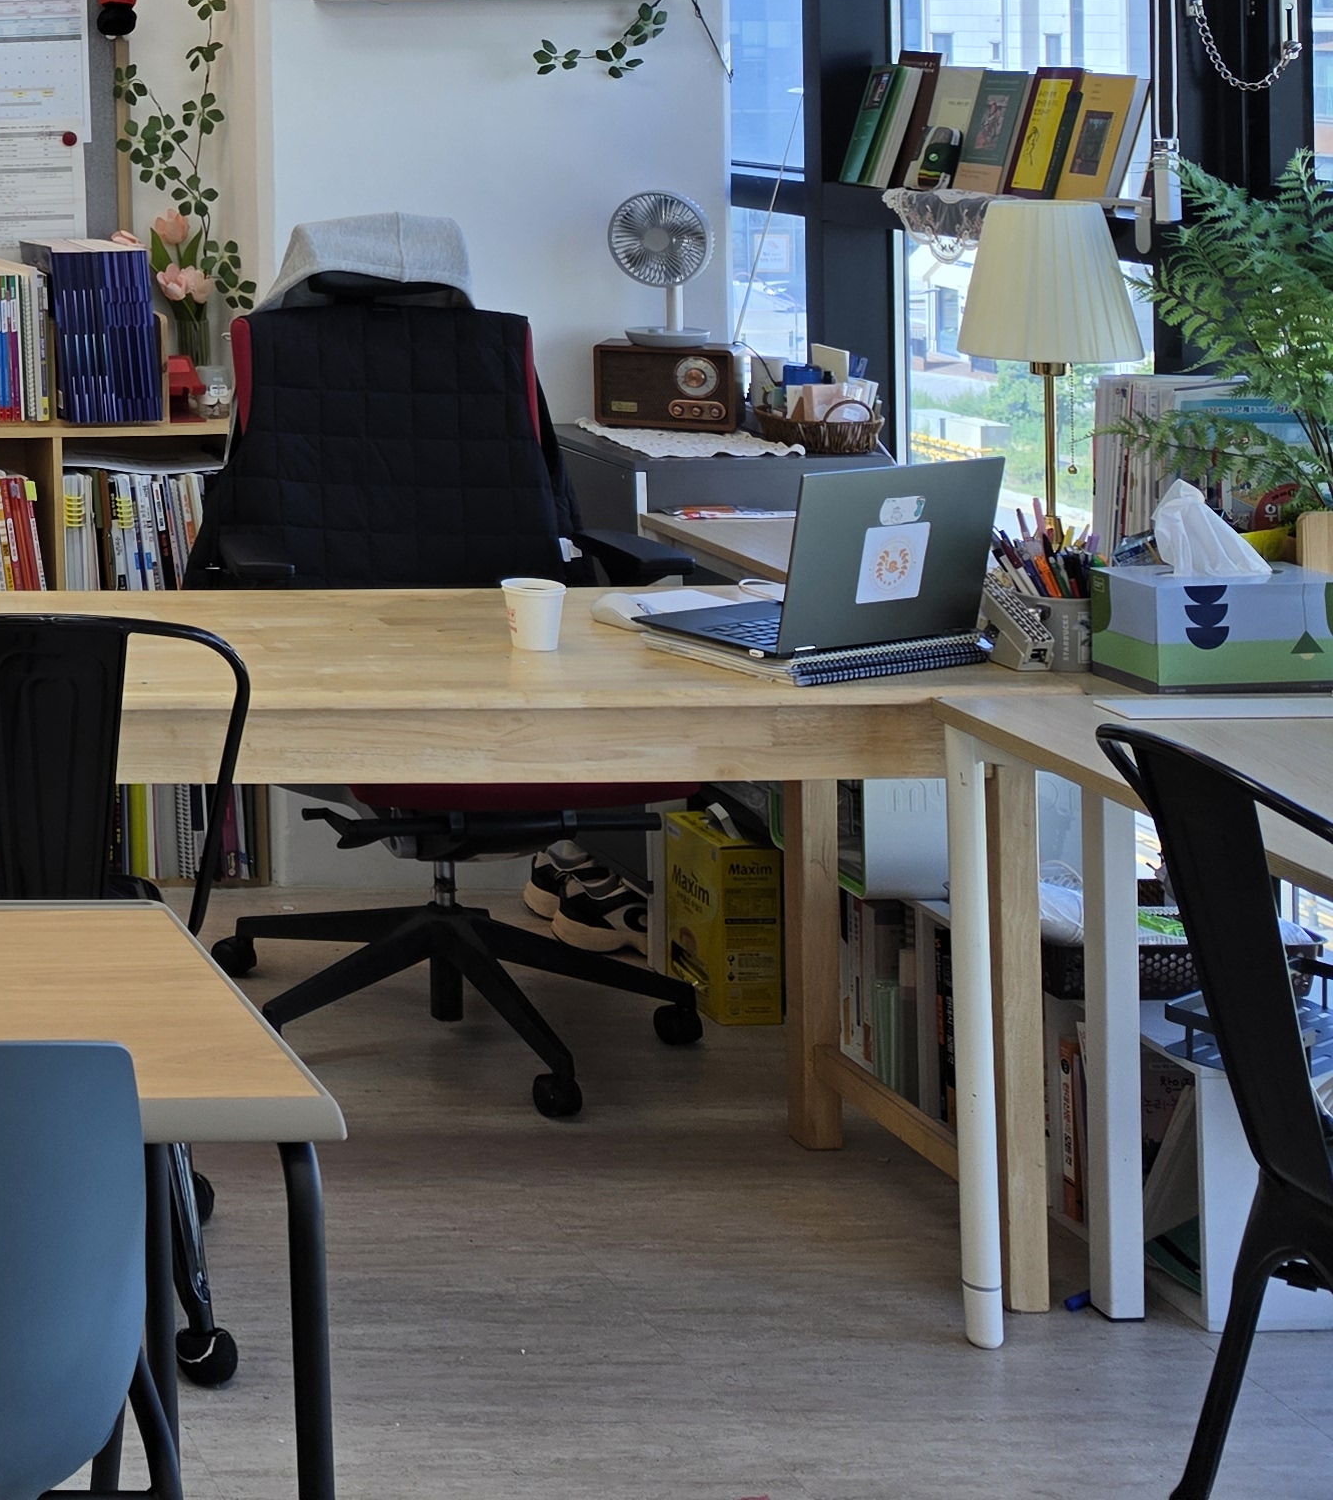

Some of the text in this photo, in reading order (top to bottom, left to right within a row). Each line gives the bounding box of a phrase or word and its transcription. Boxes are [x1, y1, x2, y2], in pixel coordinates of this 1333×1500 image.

[1062, 614, 1070, 660] STARBUCKS
[671, 864, 711, 906] Maxim
[728, 862, 773, 876] Maxim
